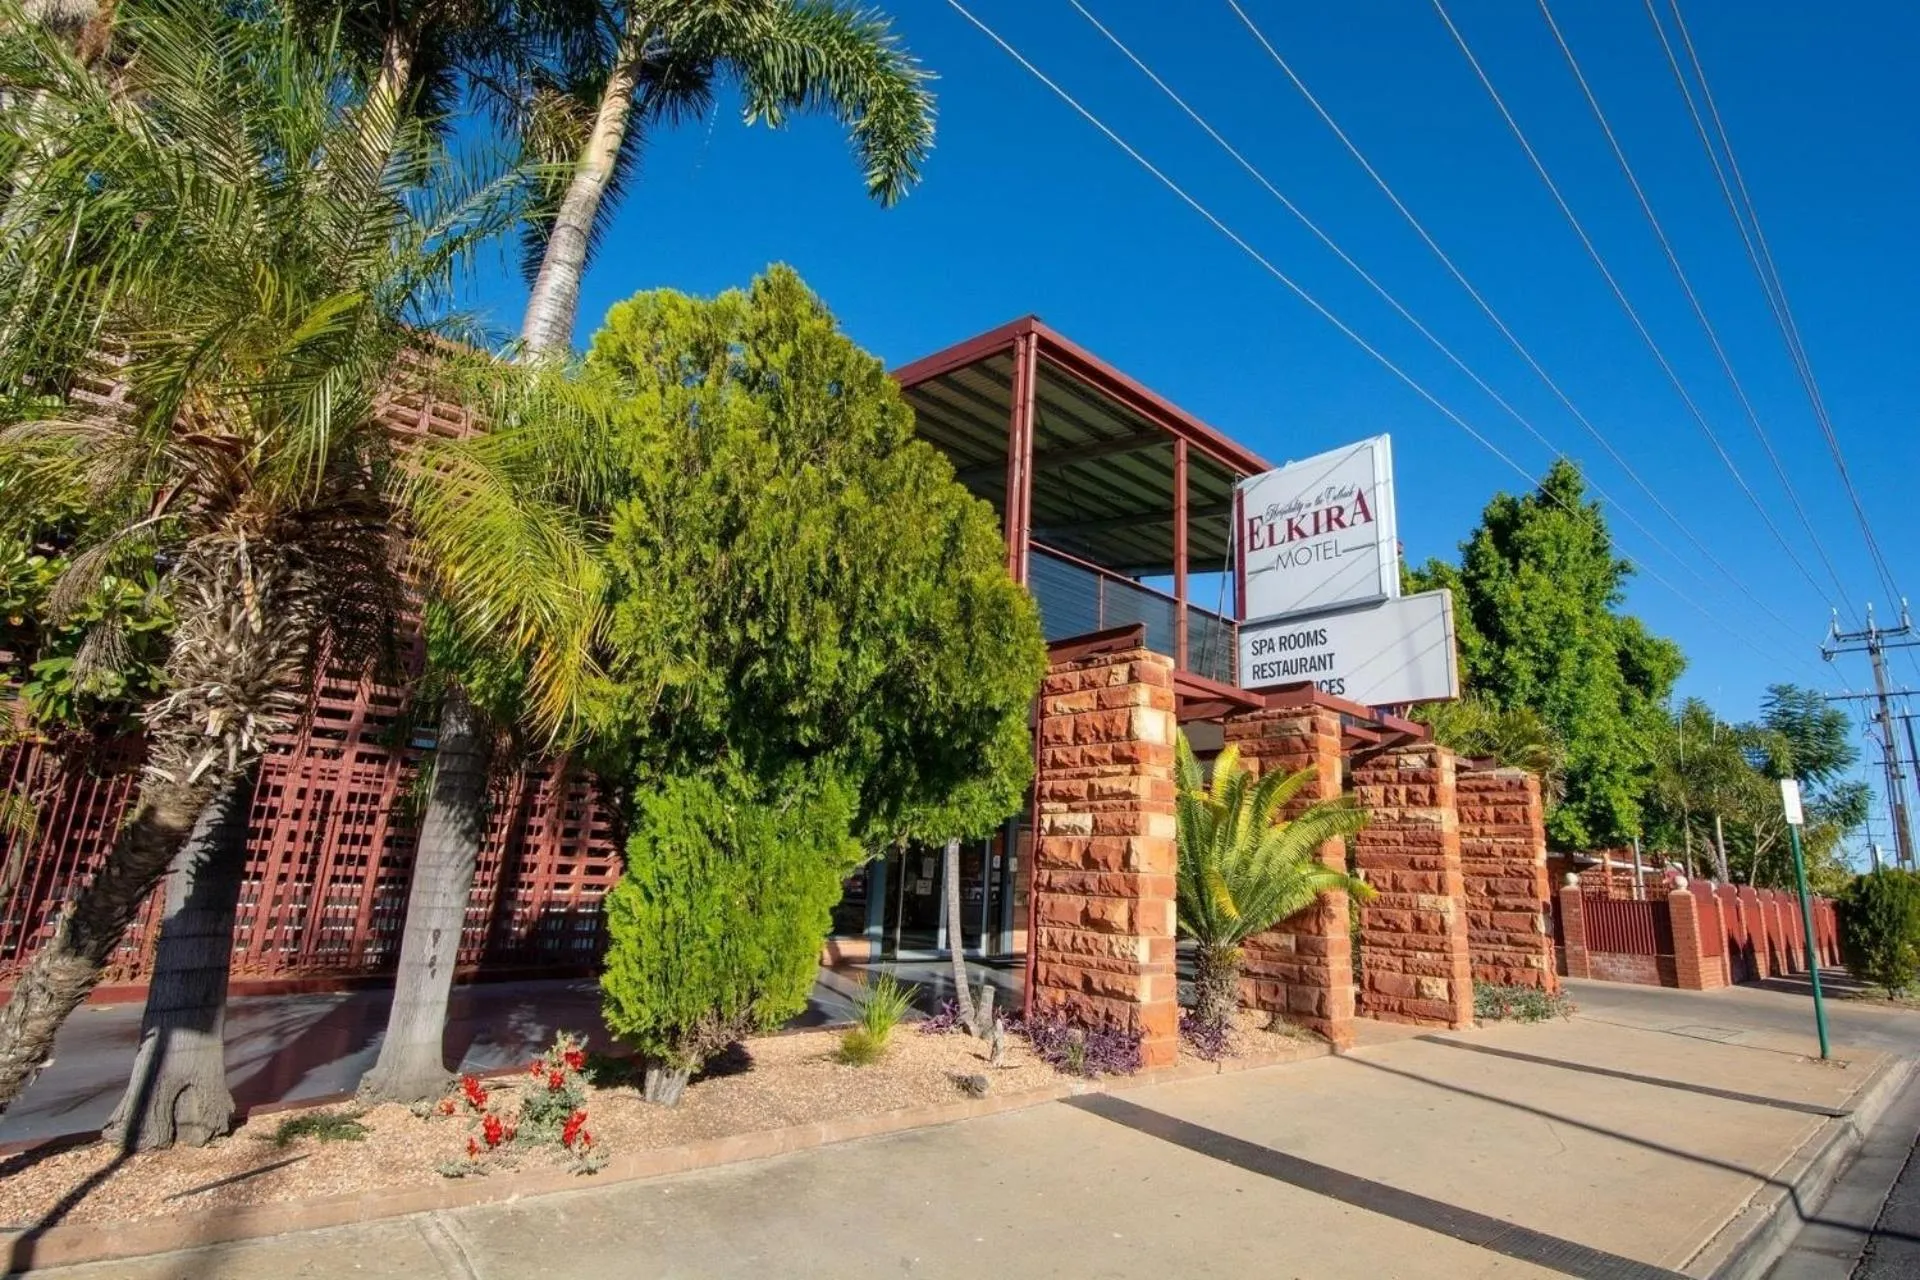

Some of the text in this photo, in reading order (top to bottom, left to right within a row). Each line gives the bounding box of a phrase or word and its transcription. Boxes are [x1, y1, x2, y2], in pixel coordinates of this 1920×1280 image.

[1248, 488, 1374, 553] ELKIRA
[1275, 540, 1341, 571] MOTEL
[1251, 628, 1327, 656] SPA ROOMS
[1252, 653, 1335, 681] RESTAURANT
